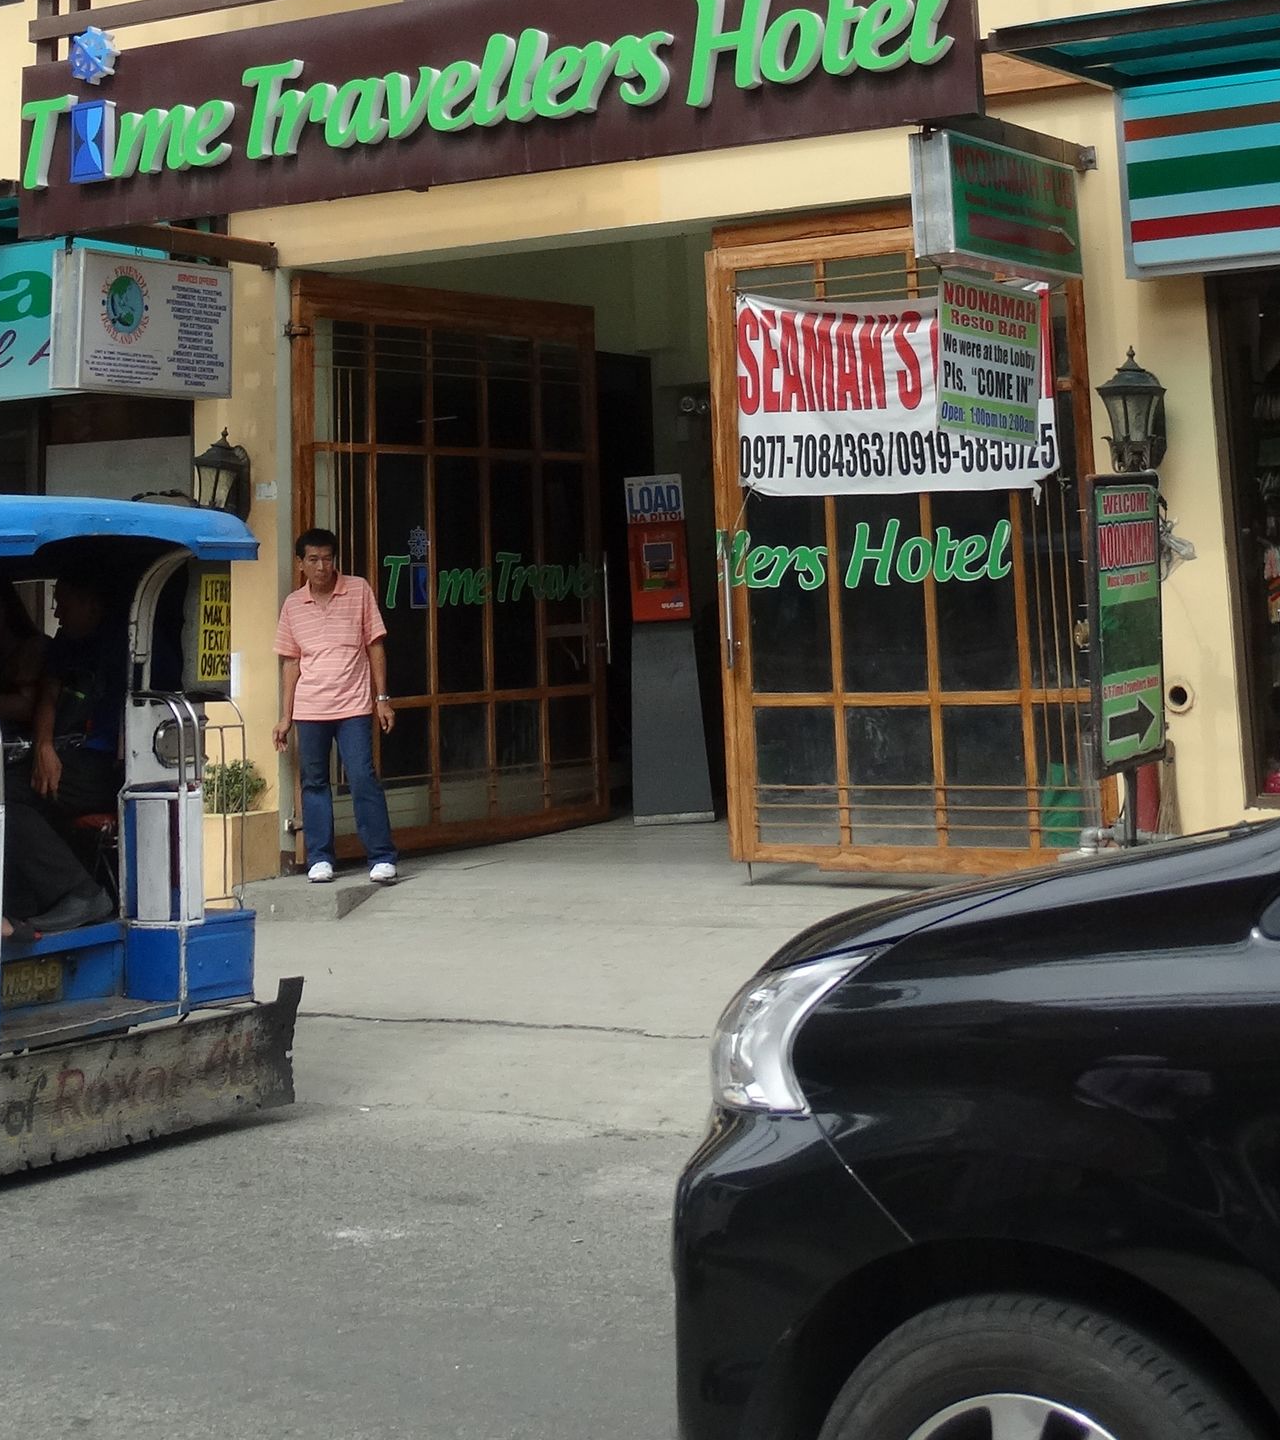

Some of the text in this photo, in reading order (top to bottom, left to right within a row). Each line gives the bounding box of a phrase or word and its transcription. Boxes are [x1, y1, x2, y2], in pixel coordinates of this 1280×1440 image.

[241, 27, 674, 161] Travellers
[943, 281, 1036, 324] NOONAMAH
[950, 309, 1028, 340] Resto BAR
[738, 306, 923, 416] SEAMAN'S
[943, 332, 1036, 372] We were at the Lobby
[943, 360, 967, 392] Pls.
[941, 400, 966, 422] Open:
[970, 407, 999, 429] 1:00pm
[999, 411, 1008, 429] to
[627, 484, 681, 514] LOAD
[1103, 491, 1150, 515] WELCOME
[630, 513, 648, 524] NA
[845, 517, 1013, 589] Hotel
